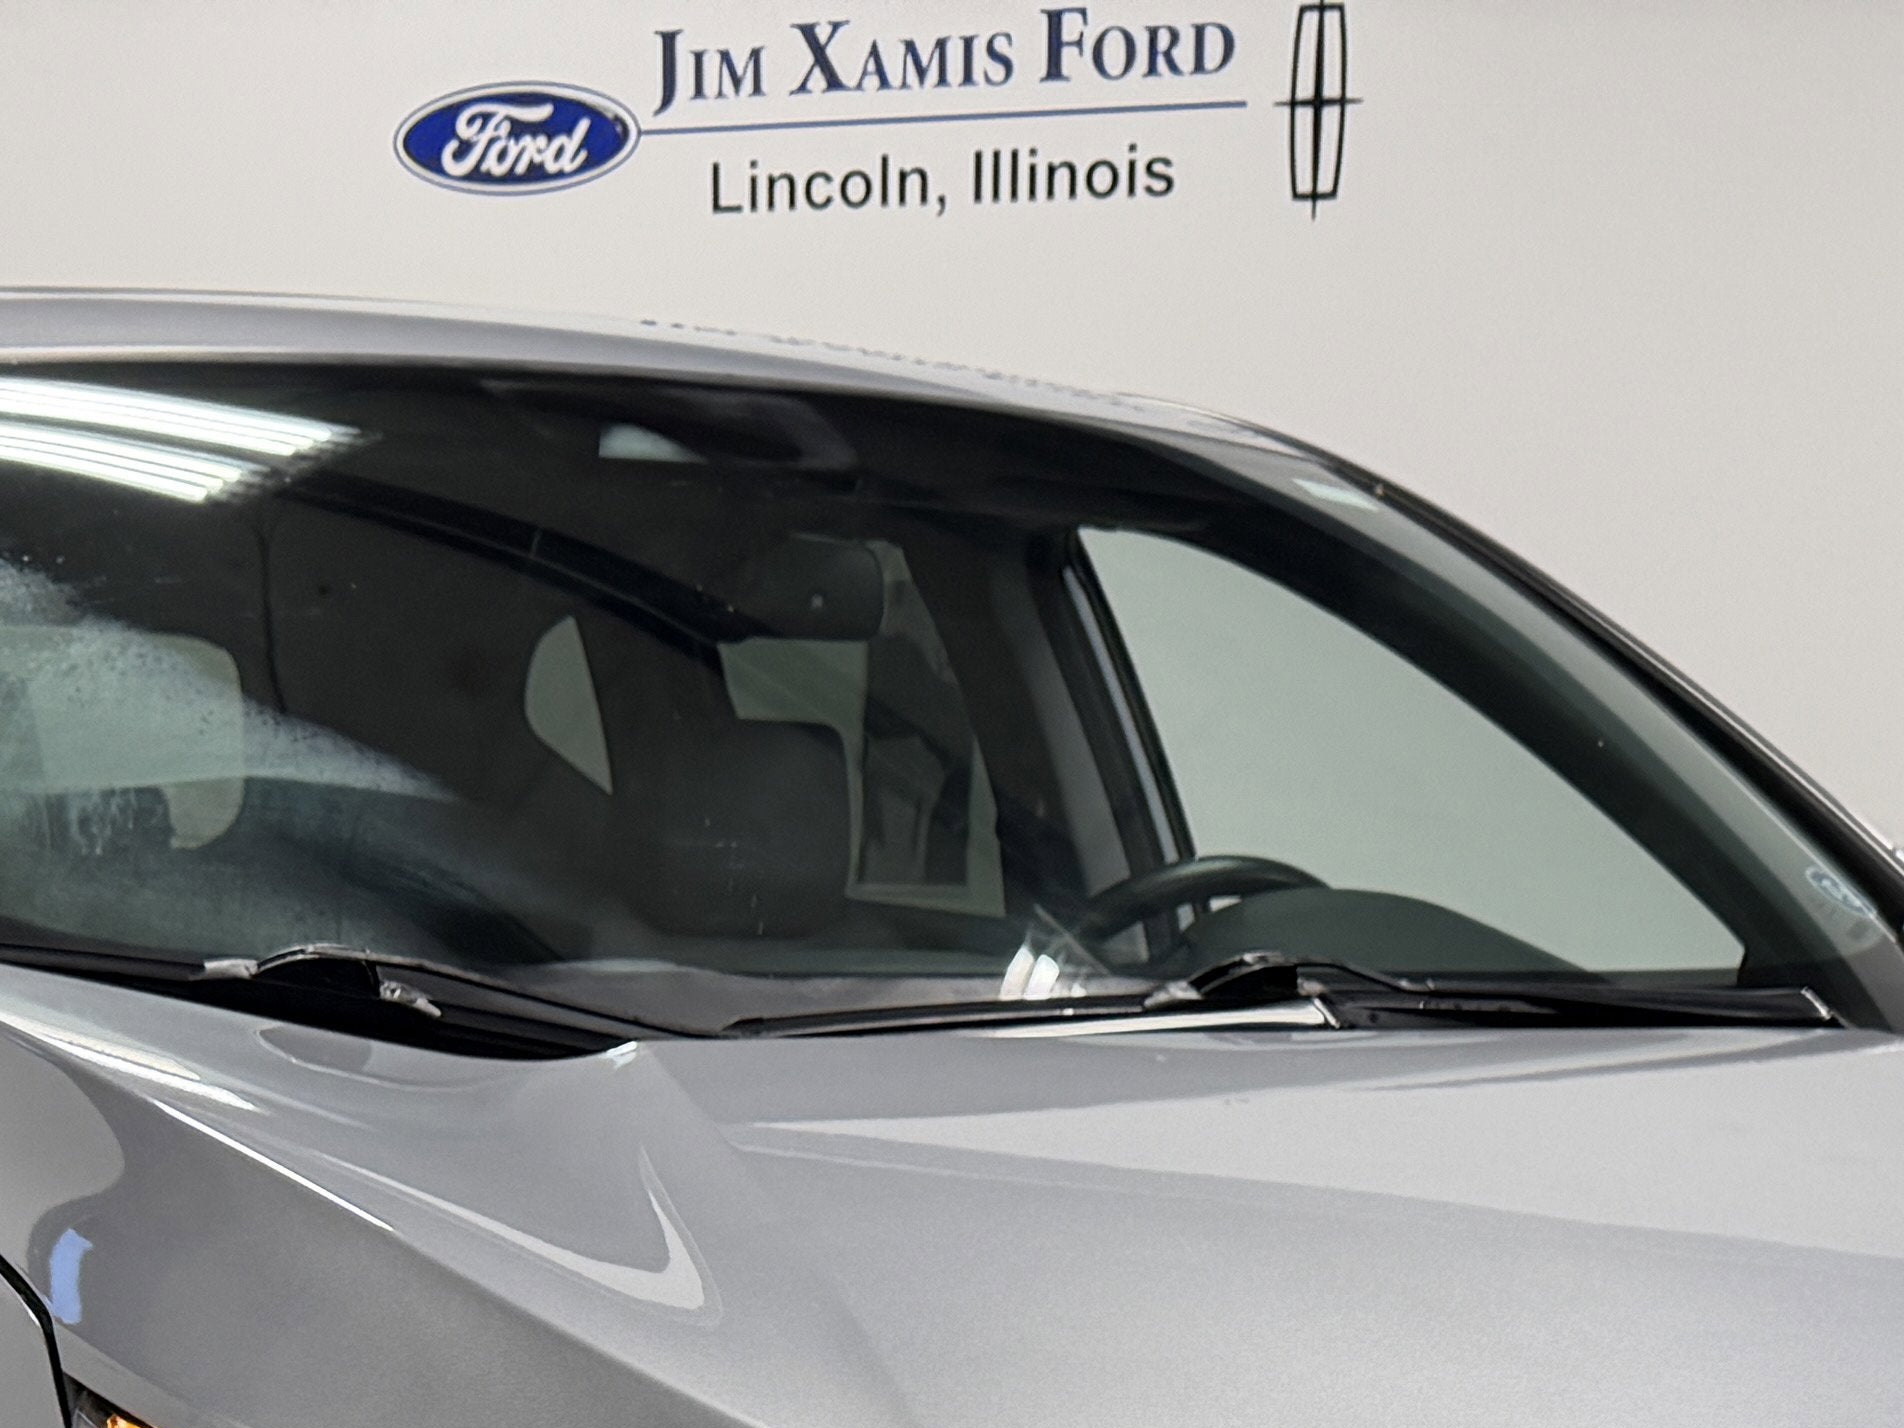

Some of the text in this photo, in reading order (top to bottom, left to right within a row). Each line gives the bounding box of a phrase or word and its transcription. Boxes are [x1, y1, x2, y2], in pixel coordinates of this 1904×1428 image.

[441, 102, 592, 178] Ford
[710, 142, 1176, 217] Lincoln, Illinois
